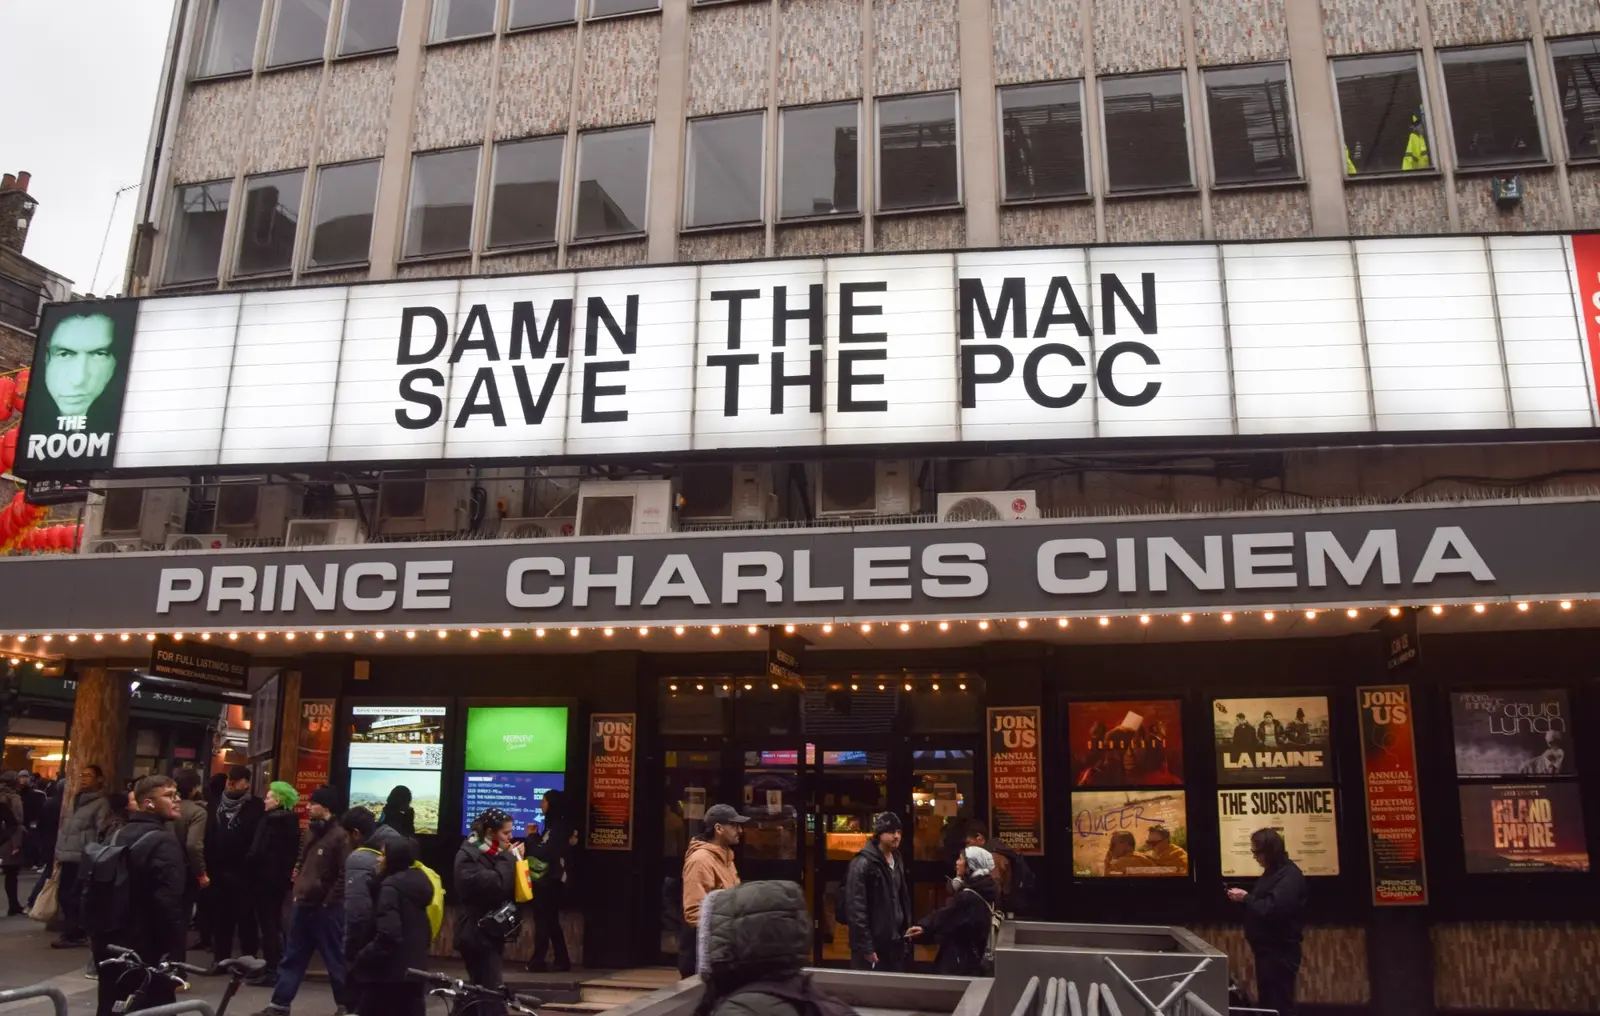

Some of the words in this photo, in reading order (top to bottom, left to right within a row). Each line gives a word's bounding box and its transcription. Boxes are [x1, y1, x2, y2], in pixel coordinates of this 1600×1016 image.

[397, 294, 640, 365] DAMN
[710, 281, 888, 349] THE
[959, 272, 1158, 340] MAN
[395, 338, 630, 430] SAVE
[707, 348, 888, 417] THE
[961, 340, 1162, 409] PCC
[57, 415, 88, 431] THE
[27, 432, 111, 461] ROOM
[156, 560, 453, 614] PRINCE
[505, 542, 989, 609] CHARLES
[1036, 525, 1497, 595] CINEMA
[157, 650, 174, 663] FOR
[175, 653, 195, 667] FULL
[196, 657, 230, 672] LISTINGS
[231, 663, 246, 675] SEE
[1362, 691, 1405, 708] JOIN
[302, 704, 333, 719] JOIN
[1371, 706, 1408, 725] US
[1503, 701, 1561, 718] david
[309, 717, 332, 733] US
[596, 722, 632, 737] JOIN
[994, 715, 1037, 732] JOIN
[603, 736, 632, 752] US
[1002, 730, 1037, 749] US
[994, 752, 1037, 760] ANNUAL
[1223, 751, 1254, 768] LA
[1255, 750, 1324, 768] HAINE
[297, 771, 329, 779] ANNUAL
[1369, 771, 1413, 779] ANNUAL
[1219, 792, 1248, 815] THE
[1250, 790, 1333, 815] SUBSTANCE
[1371, 798, 1415, 806] LIFETIME
[1490, 798, 1553, 823] INLAND
[1075, 805, 1165, 837] QUEER
[1494, 822, 1556, 848] EMPIRE
[1380, 891, 1420, 899] CINEMA
